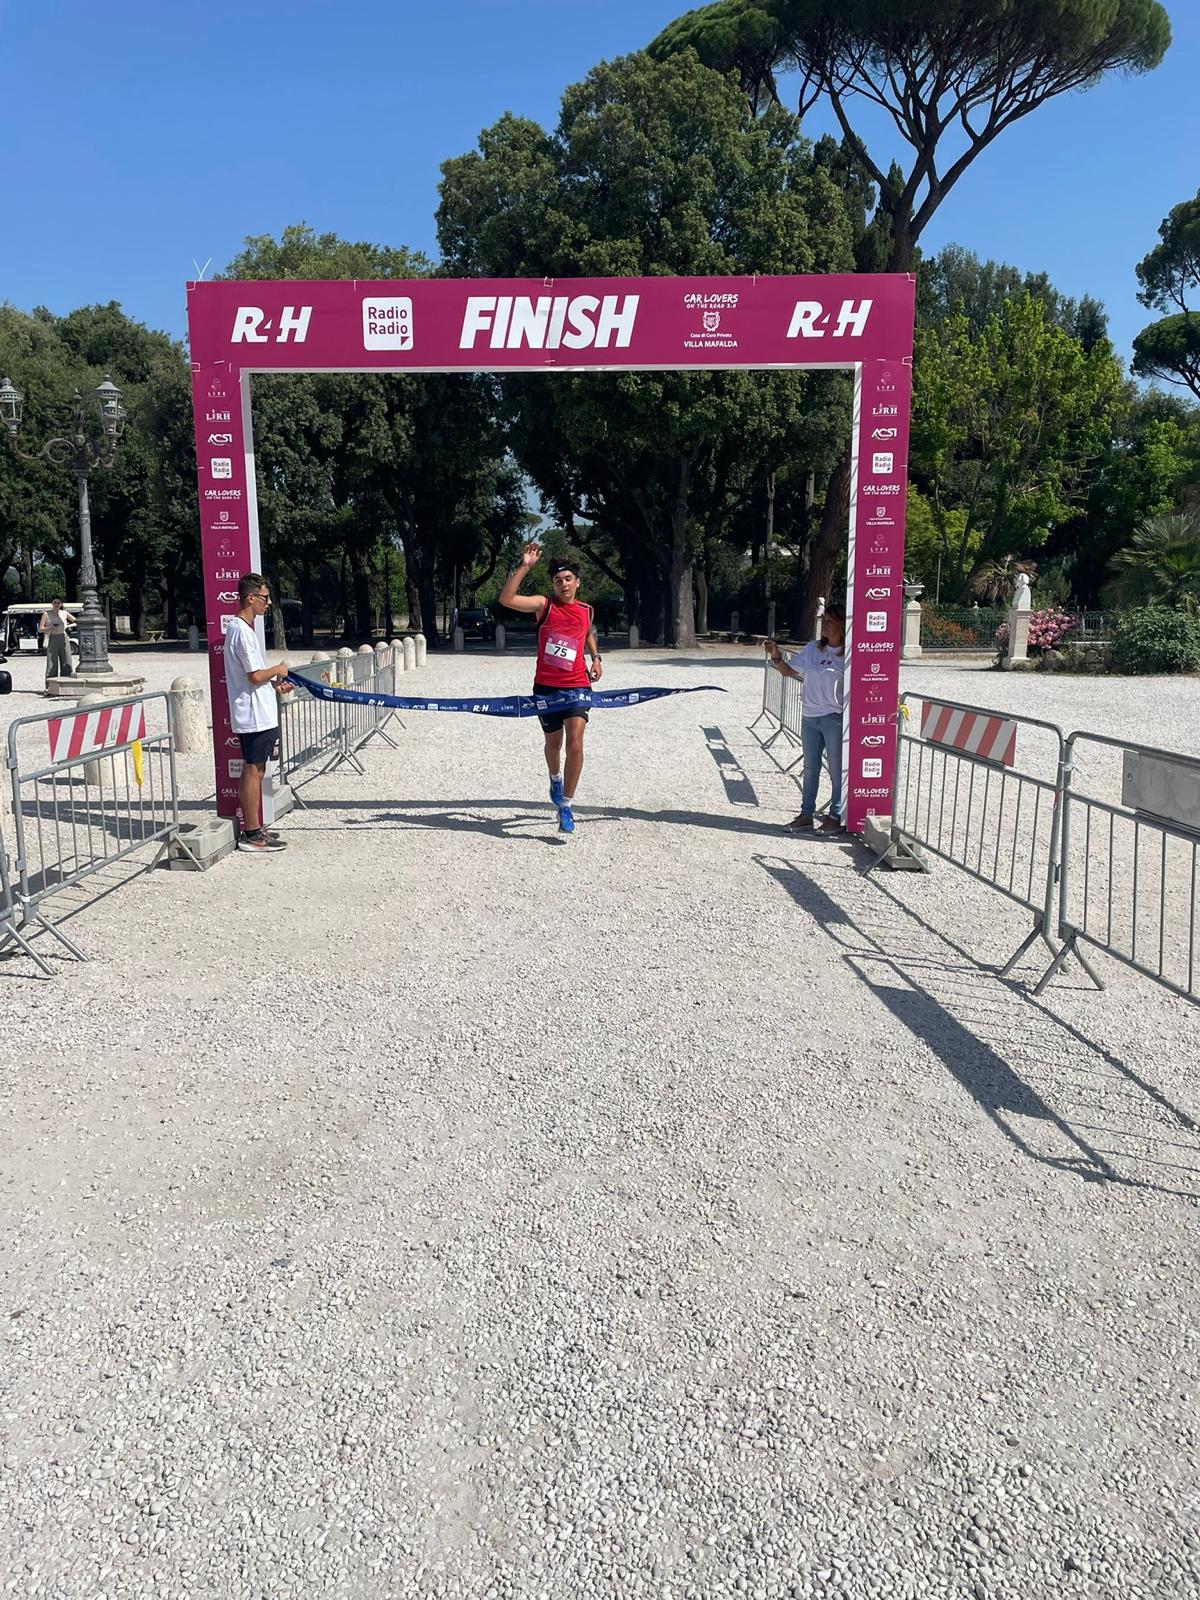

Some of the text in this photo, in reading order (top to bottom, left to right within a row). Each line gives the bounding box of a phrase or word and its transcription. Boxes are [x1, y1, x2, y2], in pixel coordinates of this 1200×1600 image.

[684, 293, 739, 304] CAR LOVERS
[368, 305, 408, 320] Radio
[459, 295, 640, 350] FINISH
[368, 321, 409, 335] Radio
[684, 340, 738, 348] VILLA MAFALDA
[217, 489, 242, 497] LOVERS
[216, 592, 240, 602] ACS
[553, 646, 568, 657] 75
[368, 698, 385, 707] RH
[472, 704, 489, 712] RH
[224, 737, 240, 747] AC
